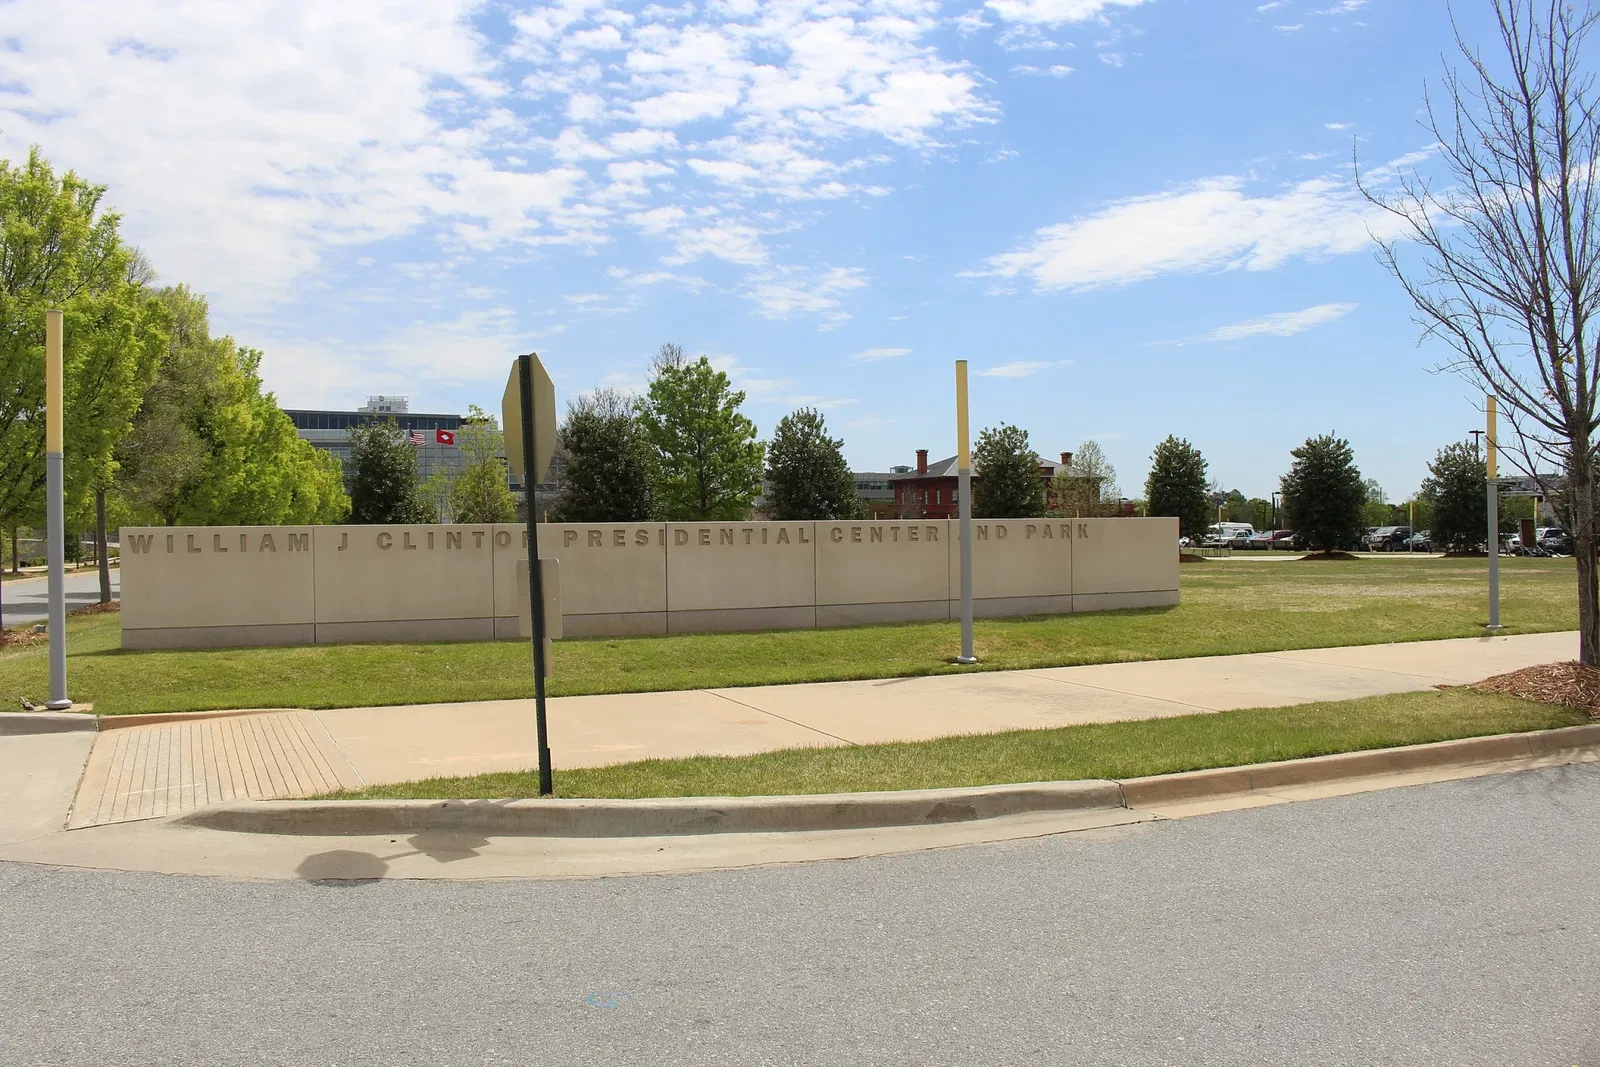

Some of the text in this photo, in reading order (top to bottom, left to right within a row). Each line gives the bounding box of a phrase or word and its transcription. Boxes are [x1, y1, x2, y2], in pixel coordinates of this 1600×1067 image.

[128, 533, 309, 554] WILLIAM
[338, 532, 348, 551] J
[563, 527, 809, 548] PRESIDENTIAL
[830, 525, 939, 543] CENTER
[958, 524, 1008, 541] ND
[1026, 523, 1089, 539] PARK
